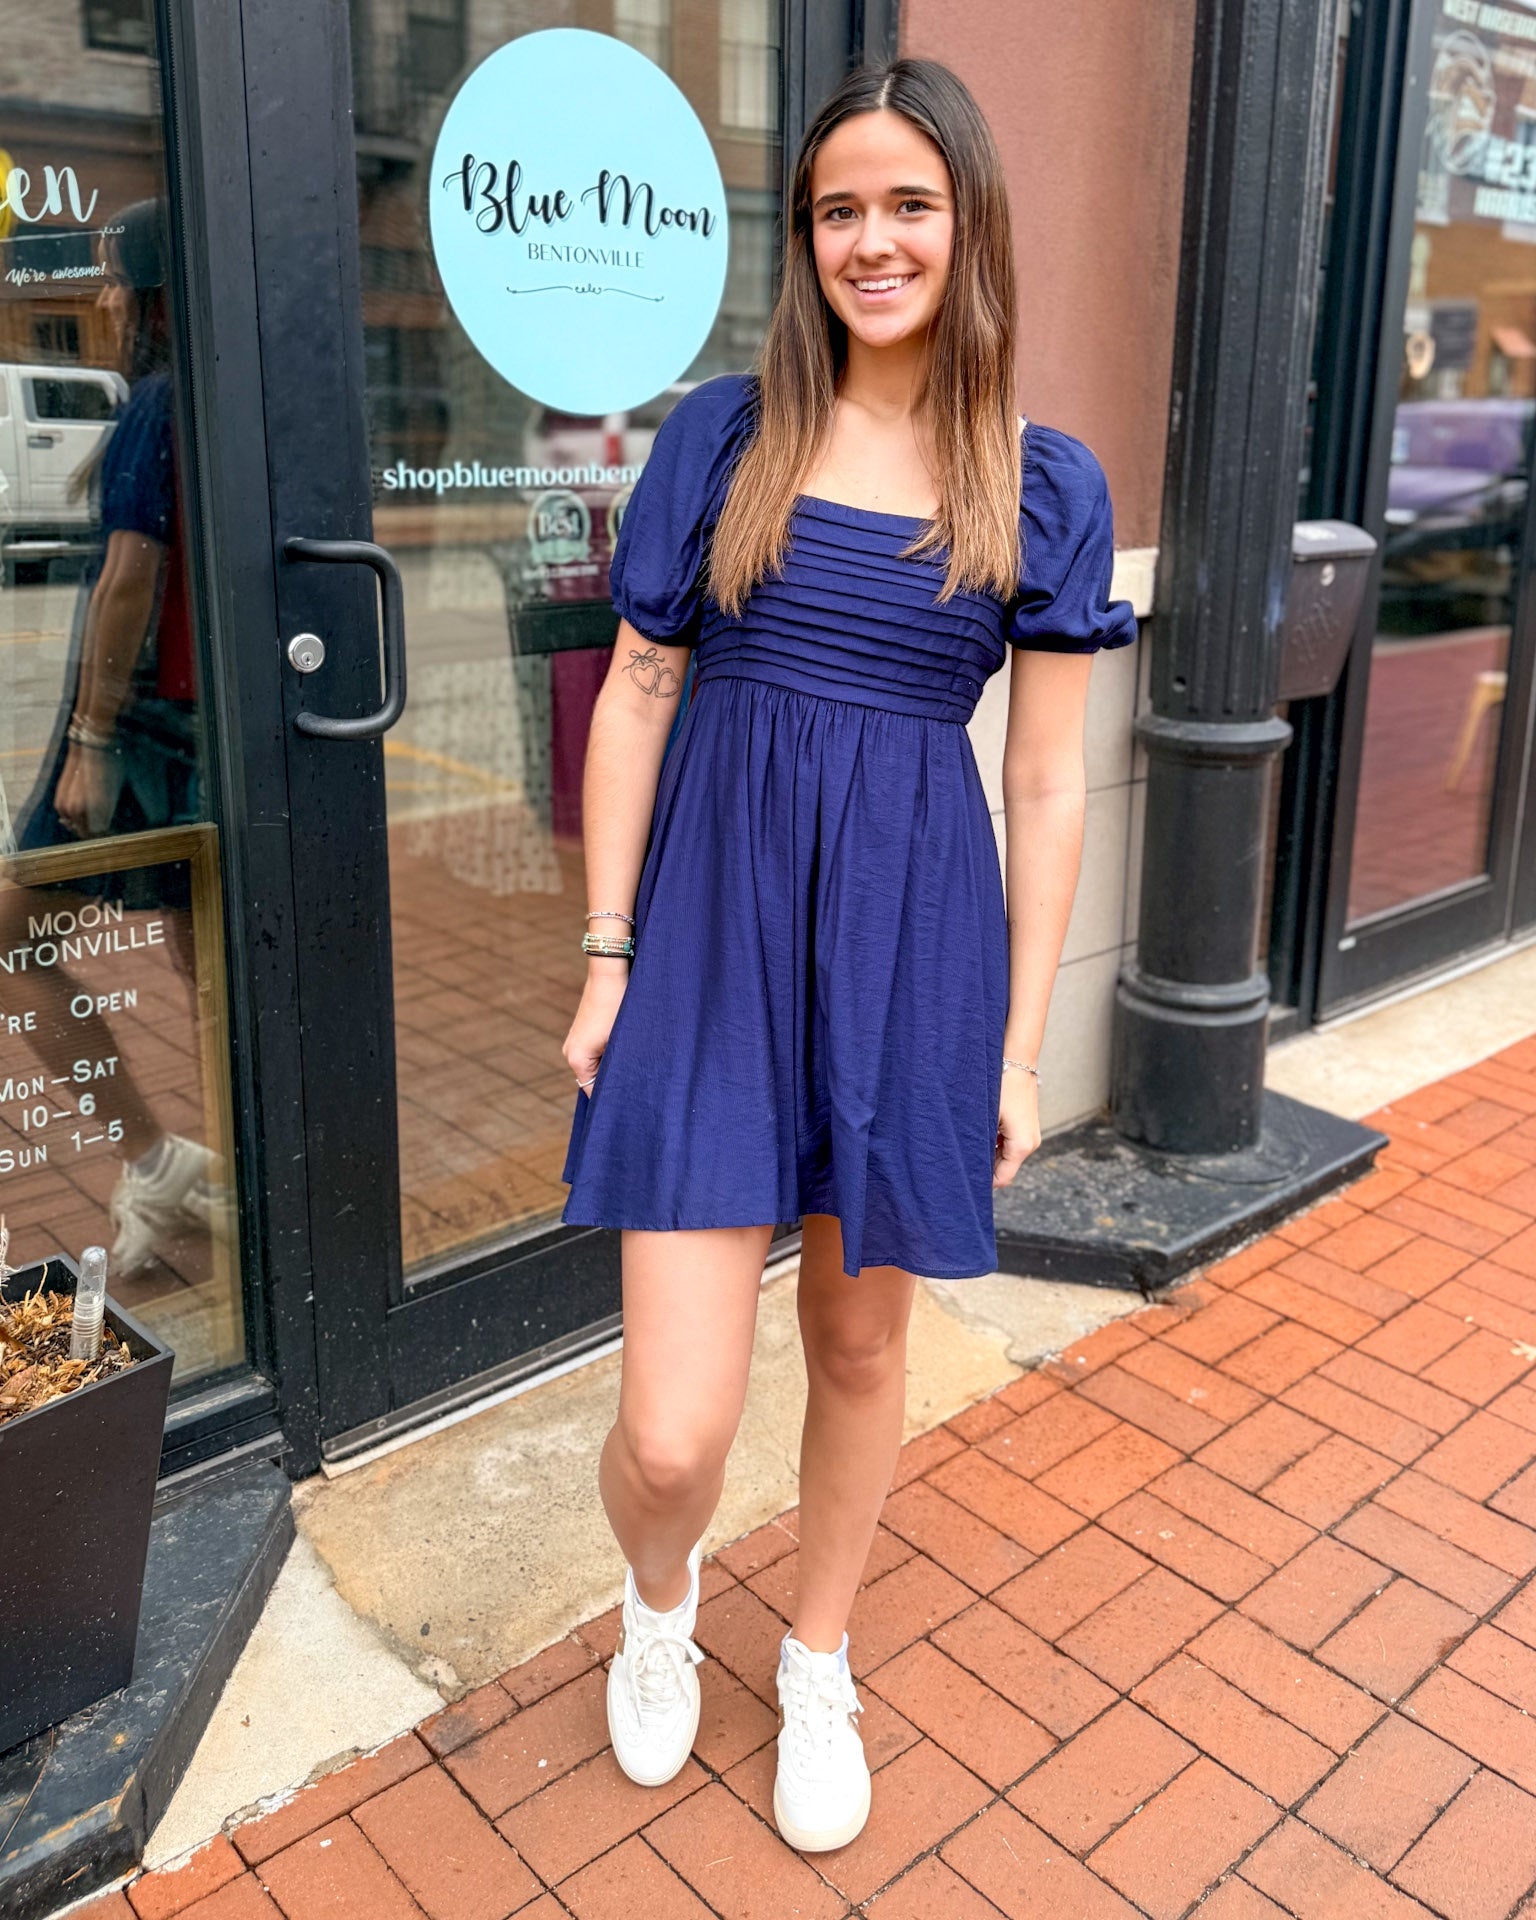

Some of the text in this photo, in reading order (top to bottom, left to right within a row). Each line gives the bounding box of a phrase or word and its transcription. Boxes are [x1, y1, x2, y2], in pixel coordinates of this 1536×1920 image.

[443, 153, 716, 237] Blue Moon
[527, 243, 645, 269] BENTONVILLE
[5, 261, 107, 287] We're awesome!
[28, 899, 124, 939] MOON
[70, 988, 138, 1018] OPEN
